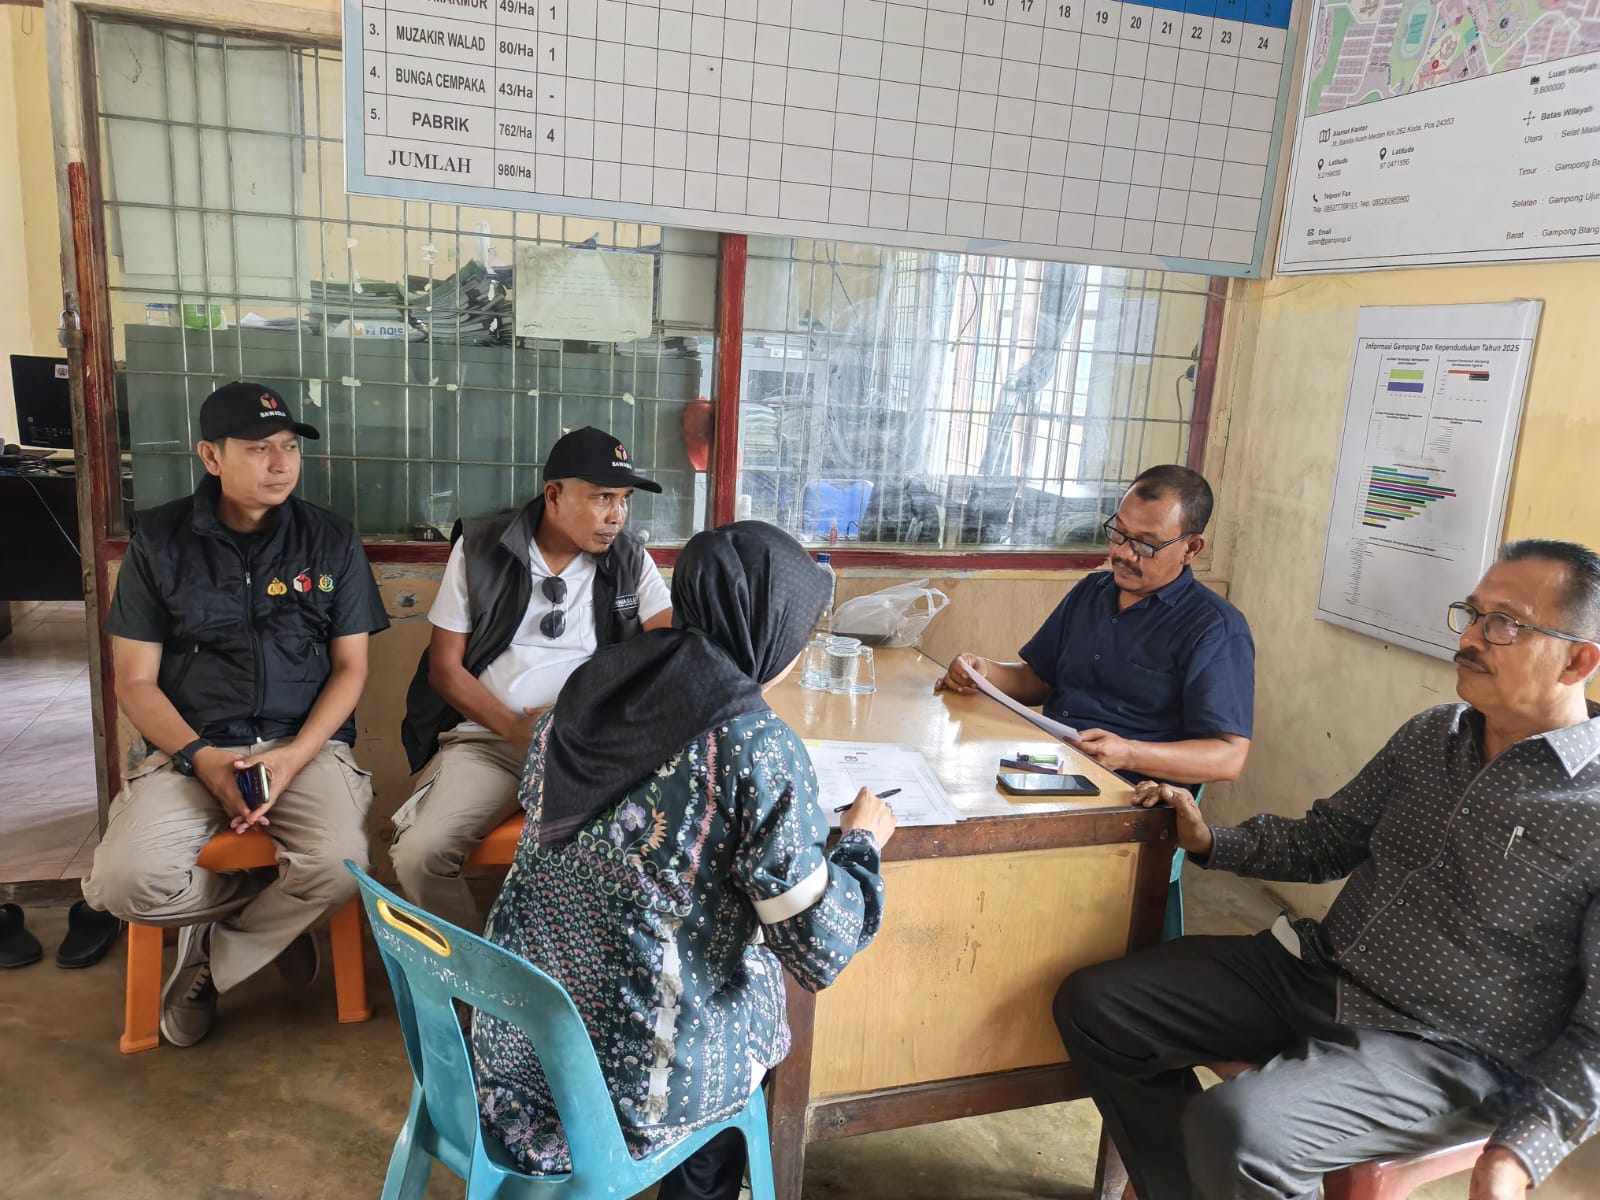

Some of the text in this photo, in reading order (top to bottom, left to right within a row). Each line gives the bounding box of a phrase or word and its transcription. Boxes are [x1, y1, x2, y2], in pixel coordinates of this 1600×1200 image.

[500, 0, 535, 16] 49/Ha
[549, 6, 556, 20] 1
[1021, 0, 1269, 50] 17 18 19 20 21 22 23 24
[369, 23, 555, 61] 3. MUZAKIR WALAD 80/Ha 1
[369, 66, 380, 78] 4.
[395, 68, 433, 87] BUNGA
[435, 73, 486, 94] CEMPAKA
[499, 83, 533, 99] 43/Ha
[370, 108, 555, 142] 5. PABRIK 762/Ha 4
[1541, 111, 1561, 120] Batas
[388, 150, 532, 179] JUMLAH 980/Ha
[1554, 160, 1590, 172] Gampong
[1511, 199, 1538, 208] Selatan
[1548, 194, 1584, 205] Gampong
[1541, 228, 1577, 238] Gampong
[1365, 342, 1393, 350] Informasi
[1393, 343, 1420, 352] Gampong
[1421, 343, 1434, 351] Dan
[1434, 343, 1480, 352] Kependudukan
[1481, 344, 1501, 352] Tahun
